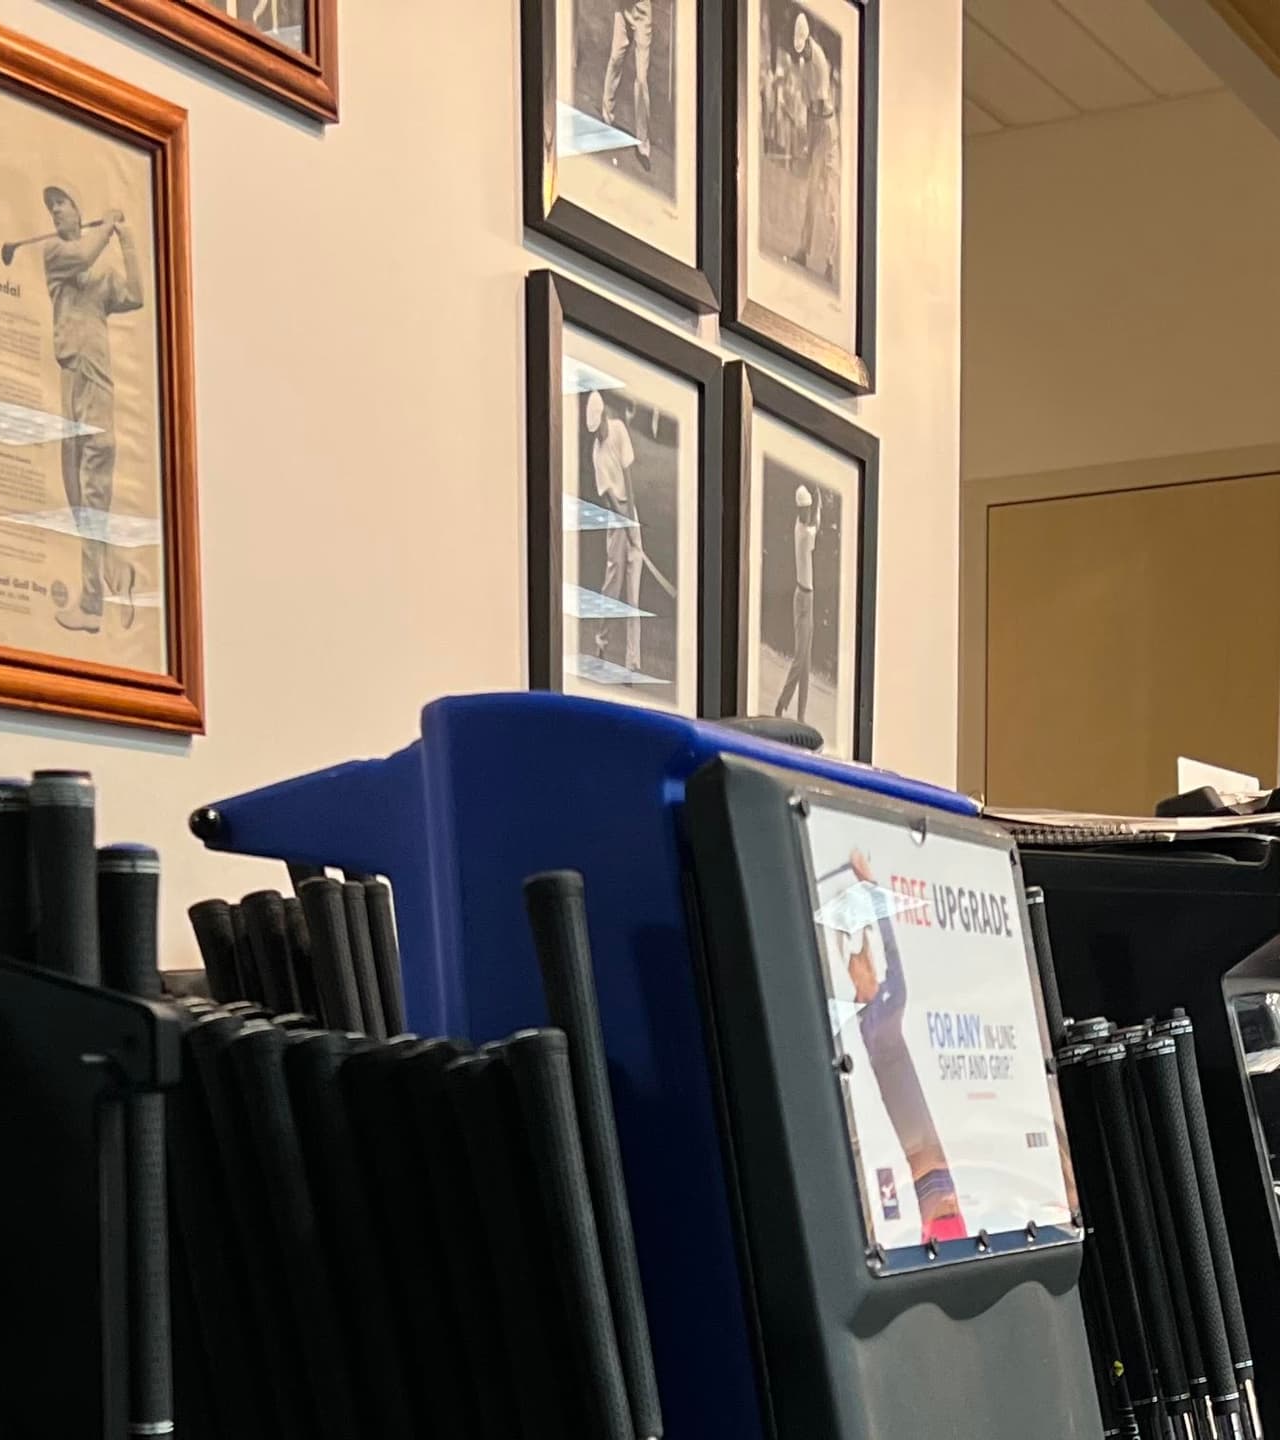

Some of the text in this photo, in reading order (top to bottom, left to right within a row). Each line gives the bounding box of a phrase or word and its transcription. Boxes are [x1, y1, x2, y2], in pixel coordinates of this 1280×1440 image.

[890, 875, 1014, 938] FREE UPGRADE
[926, 1011, 956, 1049] FOR
[956, 1013, 984, 1050] ANY
[938, 1054, 967, 1082] SHAFT
[968, 1055, 989, 1081] AND
